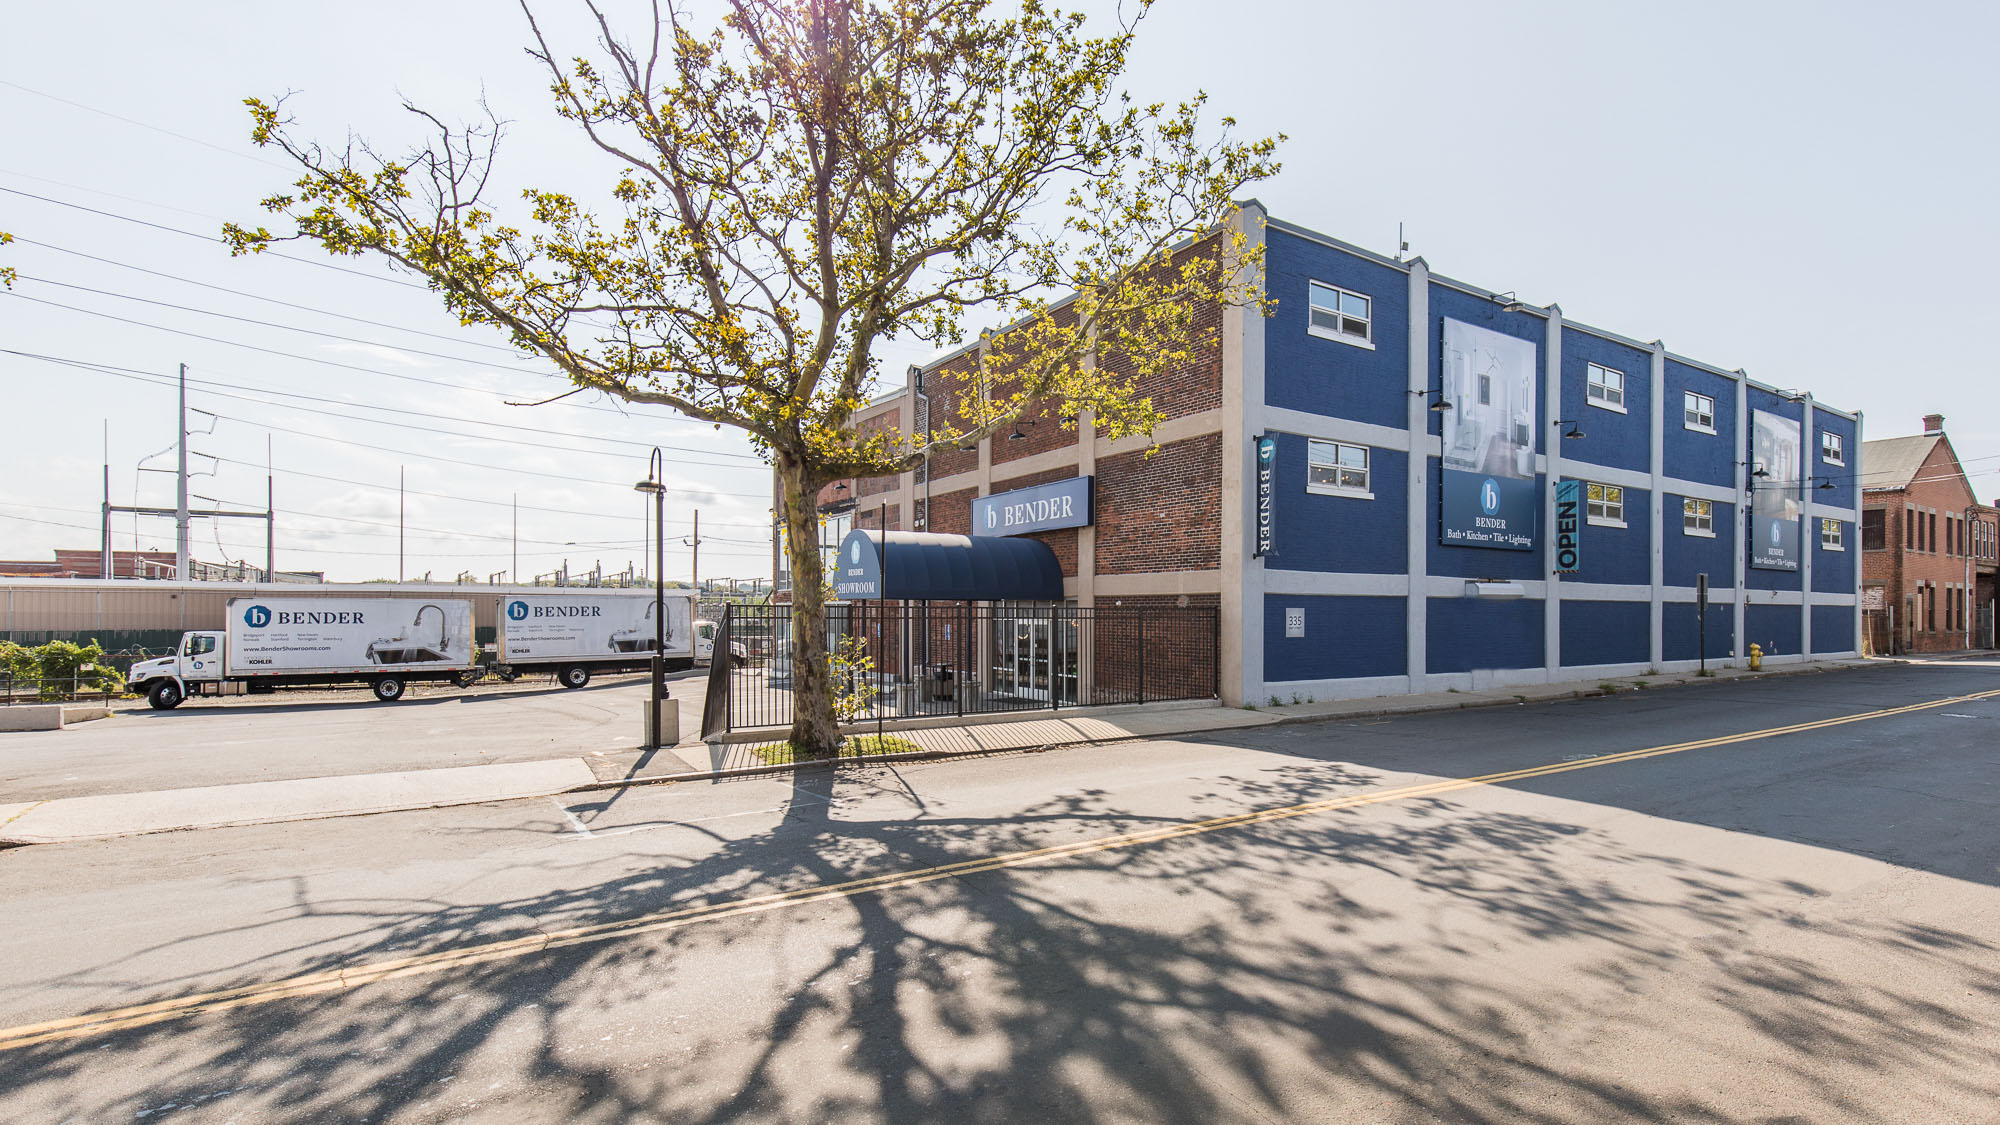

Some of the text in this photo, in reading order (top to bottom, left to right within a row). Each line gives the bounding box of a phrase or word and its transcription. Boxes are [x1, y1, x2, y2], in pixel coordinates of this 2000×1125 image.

[1004, 495, 1073, 526] BENDER
[1260, 468, 1270, 552] BENDER
[1476, 517, 1506, 529] BENDER
[1447, 529, 1531, 547] Bath Kitchen Tile Lighting
[1558, 501, 1577, 568] OPEN
[848, 568, 863, 576] BENDER
[838, 582, 874, 593] SHOWROOM
[534, 606, 601, 617] BENDER
[278, 612, 364, 624] BENDER
[1289, 616, 1302, 626] 335
